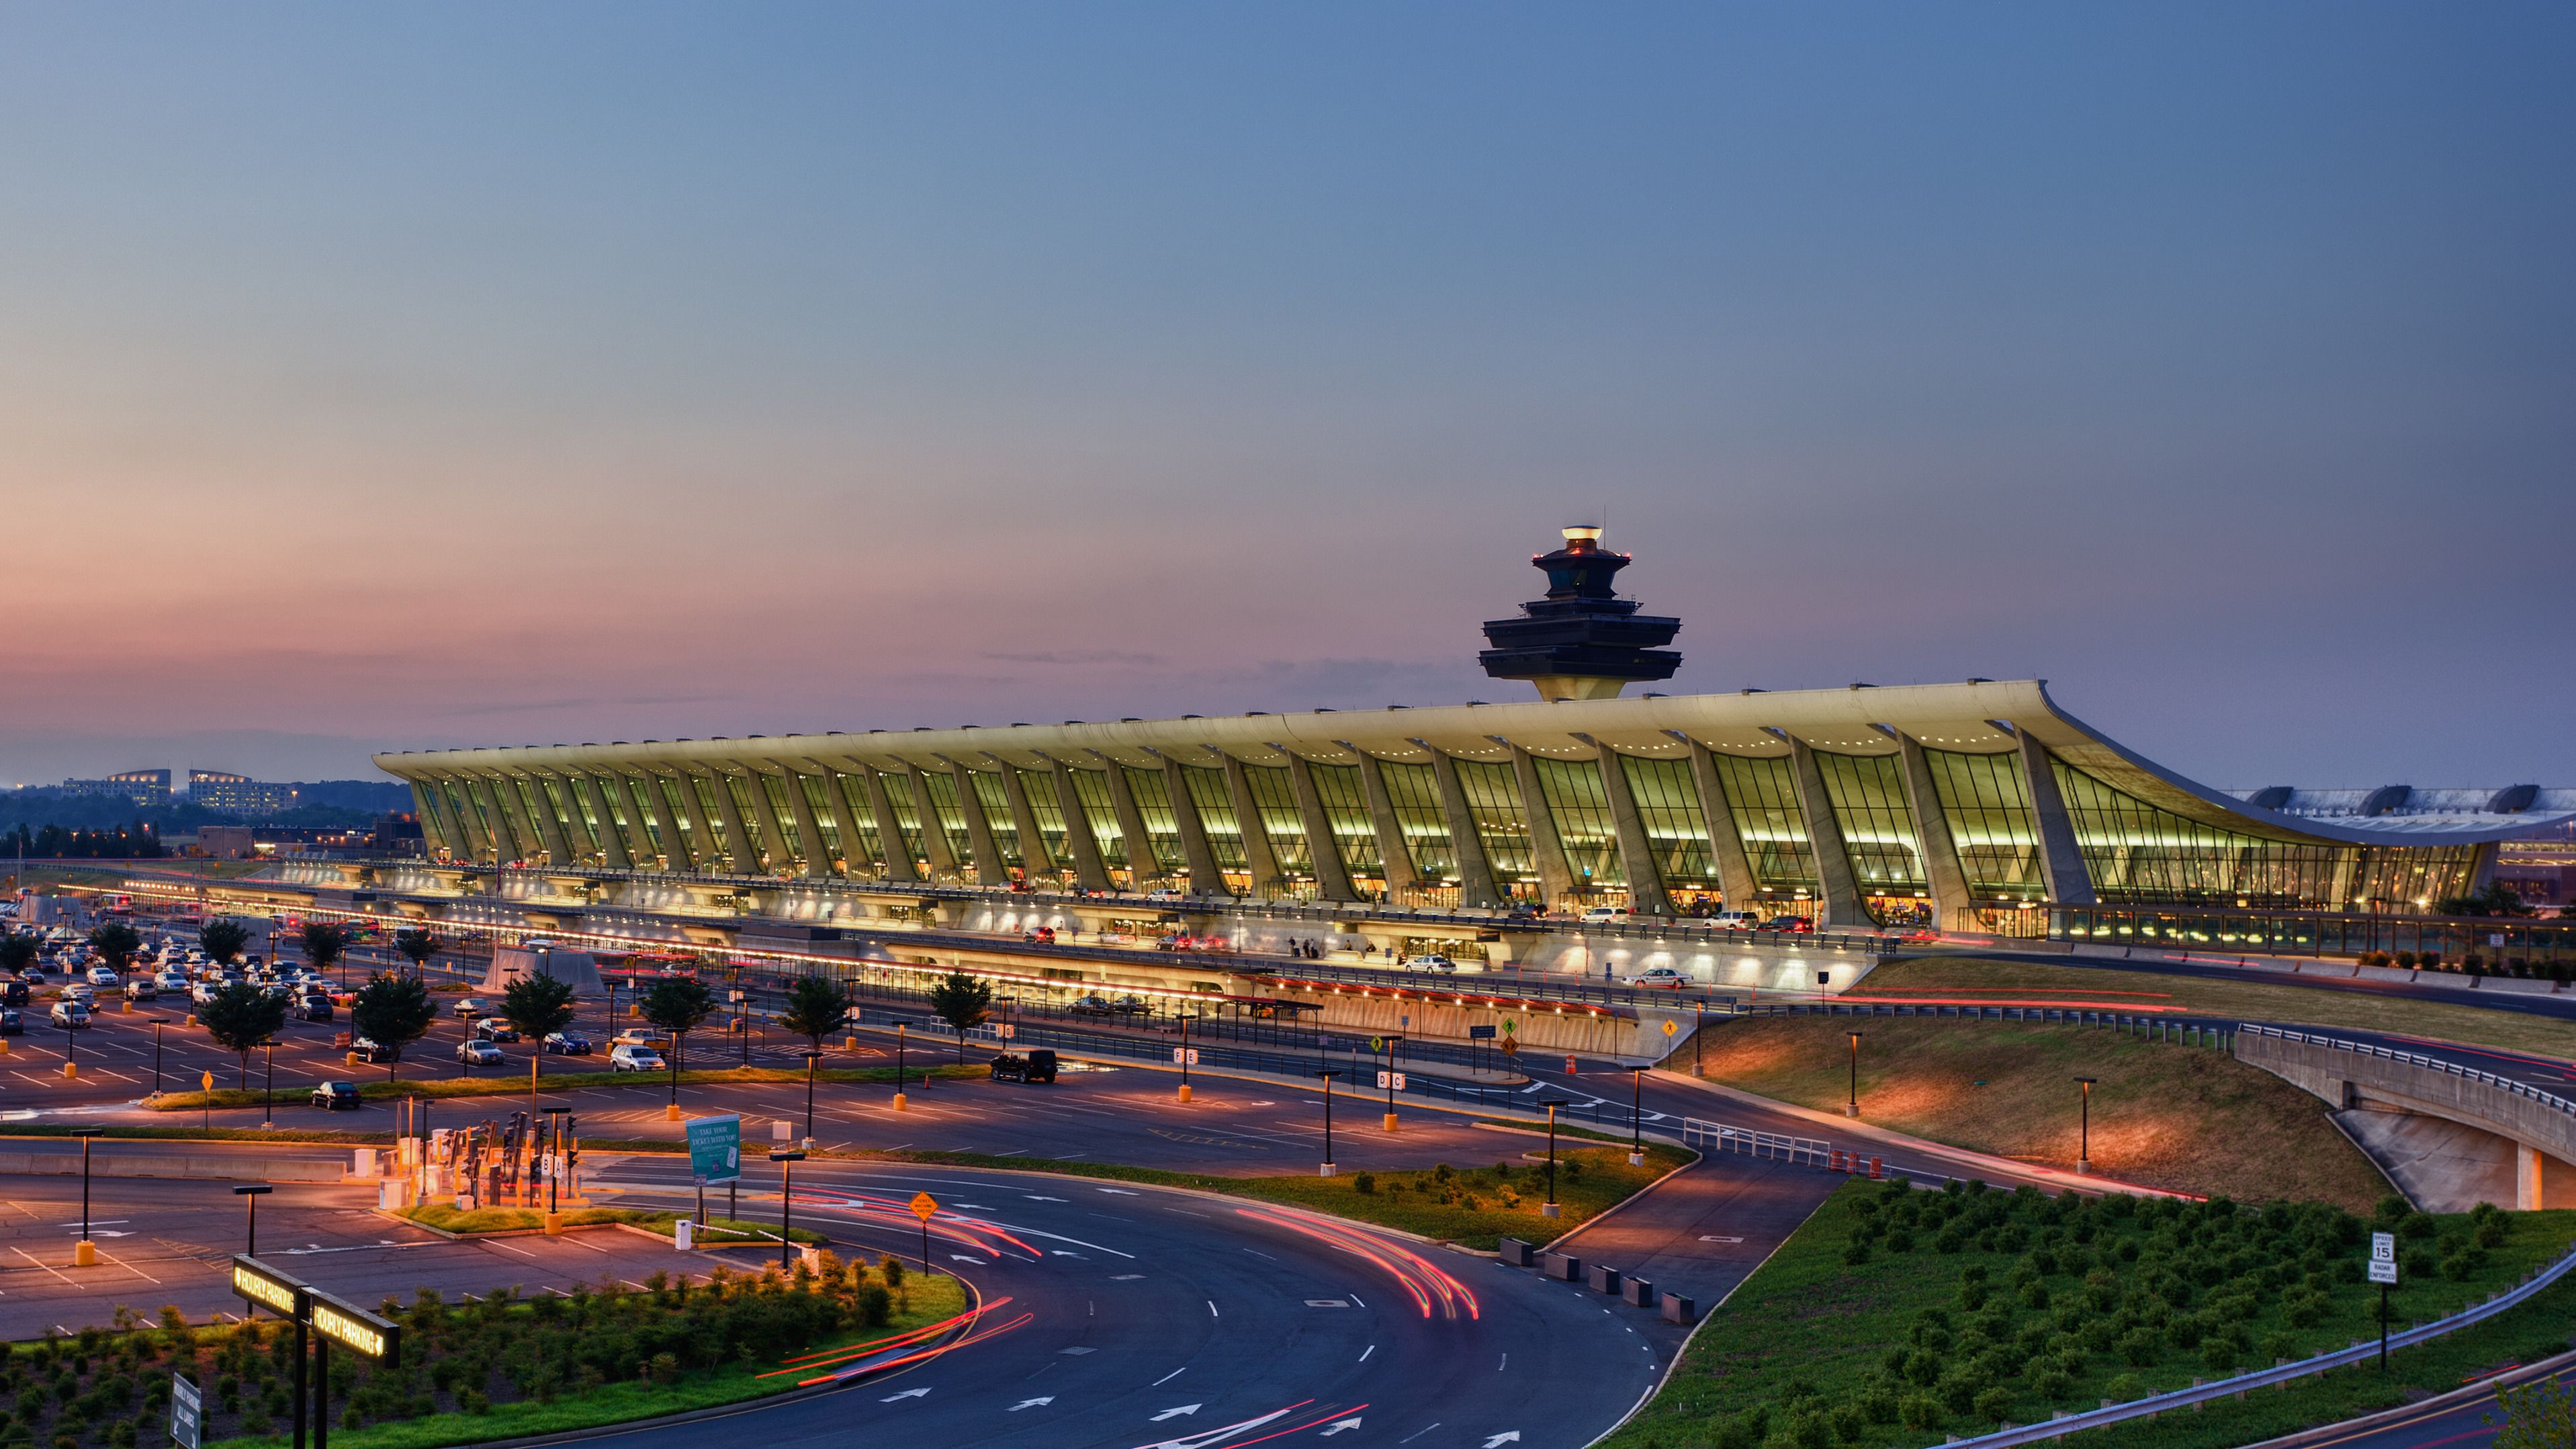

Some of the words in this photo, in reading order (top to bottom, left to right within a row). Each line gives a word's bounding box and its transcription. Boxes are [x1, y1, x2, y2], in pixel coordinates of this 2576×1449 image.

[1189, 1053, 1193, 1061] E
[1380, 1075, 1385, 1084] D
[1394, 1077, 1400, 1086] C
[699, 1128, 713, 1136] TAKE
[713, 1126, 727, 1134] YOUR
[691, 1137, 711, 1146] TICKET
[711, 1135, 725, 1144] WITH
[725, 1134, 737, 1142] YOU
[544, 1159, 549, 1170] B
[556, 1161, 561, 1174] A
[2376, 1247, 2390, 1258] 15
[2374, 1264, 2391, 1272] RADAR
[2369, 1271, 2396, 1280] ENFORCED
[242, 1269, 267, 1299] HOURLY
[266, 1282, 295, 1314] PARKING
[314, 1305, 341, 1337] HOURLY
[342, 1318, 374, 1354] PARKING
[174, 1381, 186, 1401] HOURLY
[186, 1391, 200, 1413] PARKING
[183, 1409, 194, 1429] LANES
